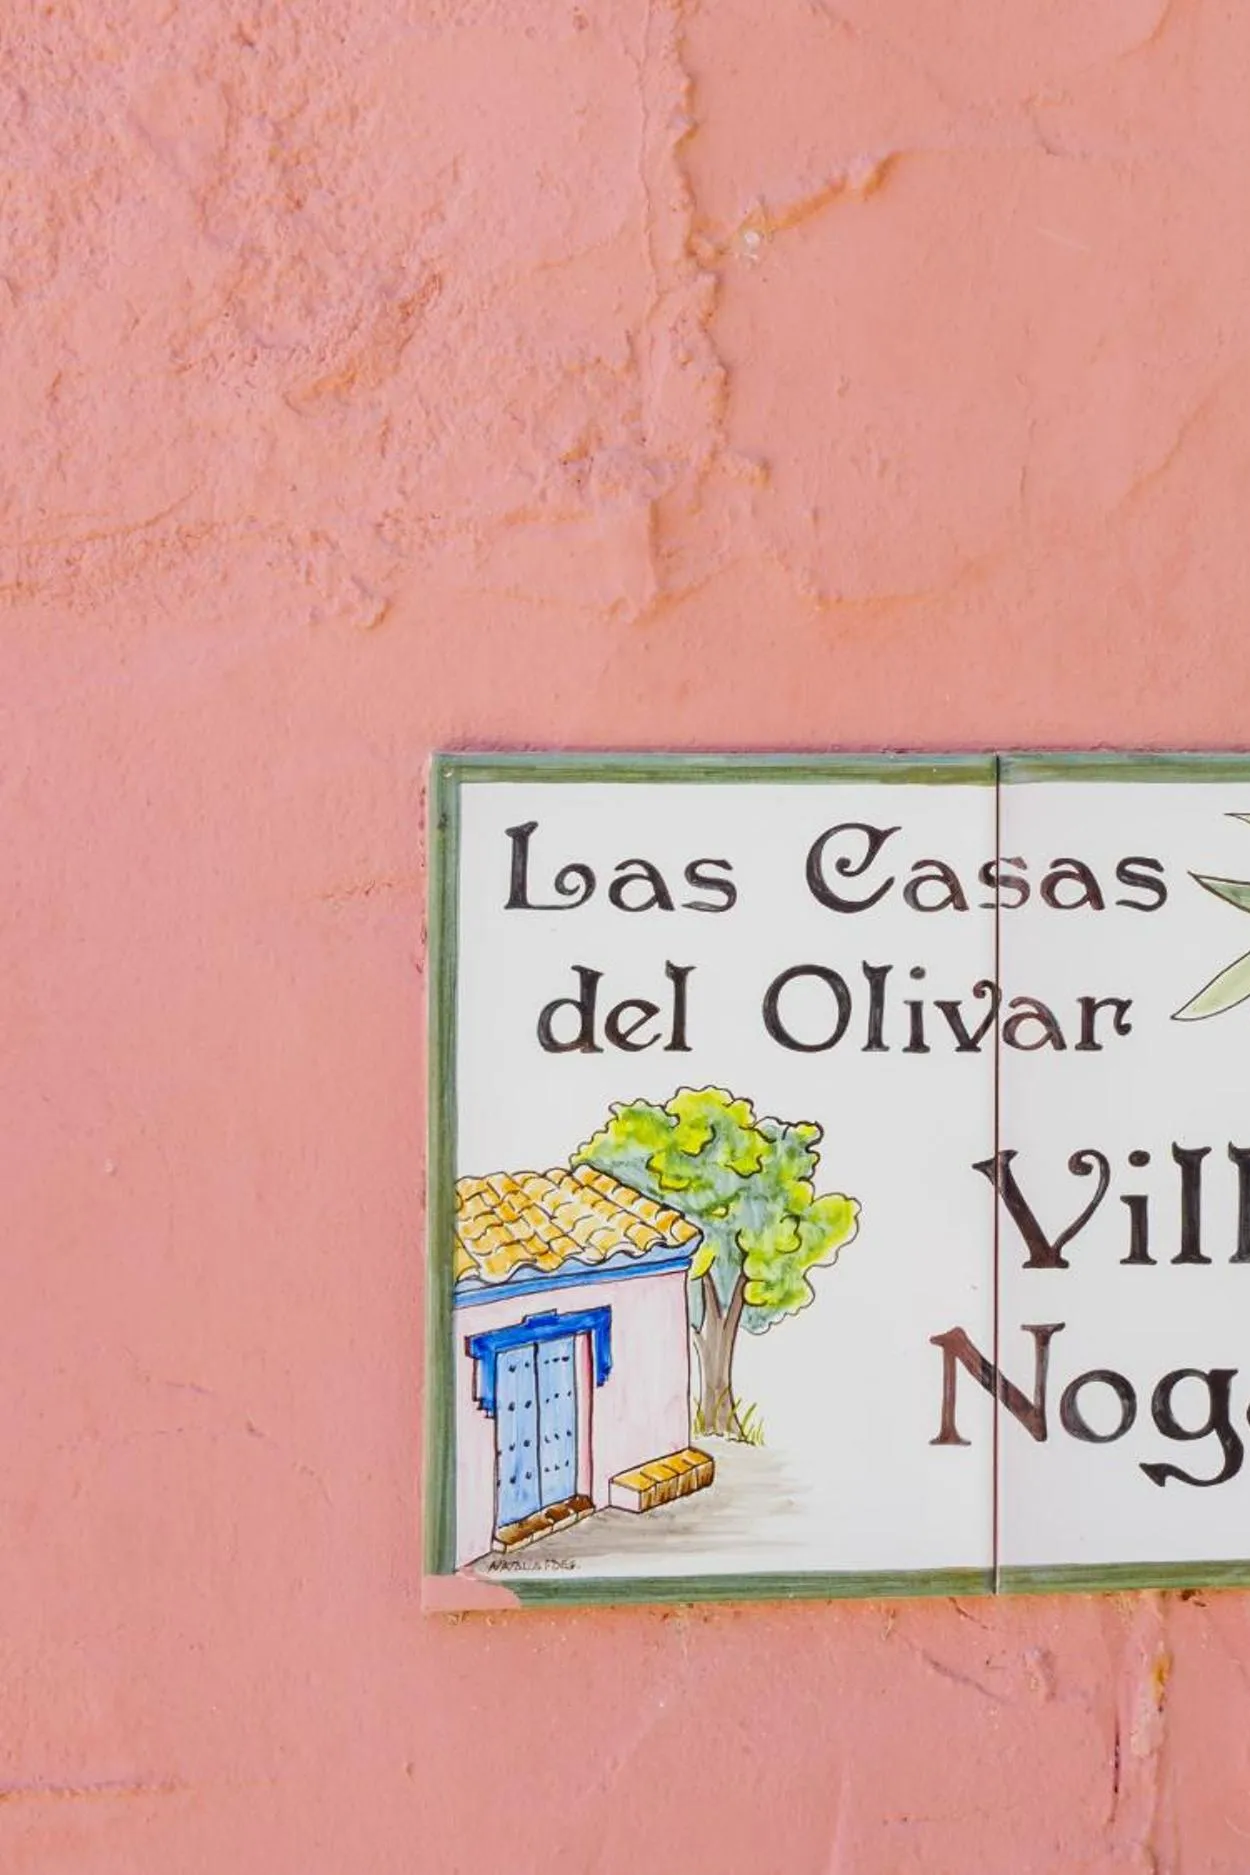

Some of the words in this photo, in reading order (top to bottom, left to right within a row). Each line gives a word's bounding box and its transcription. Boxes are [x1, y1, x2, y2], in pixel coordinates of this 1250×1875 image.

[505, 822, 737, 913] Las
[806, 822, 1168, 914] Casas
[538, 961, 696, 1054] del
[763, 961, 1133, 1053] Olivar
